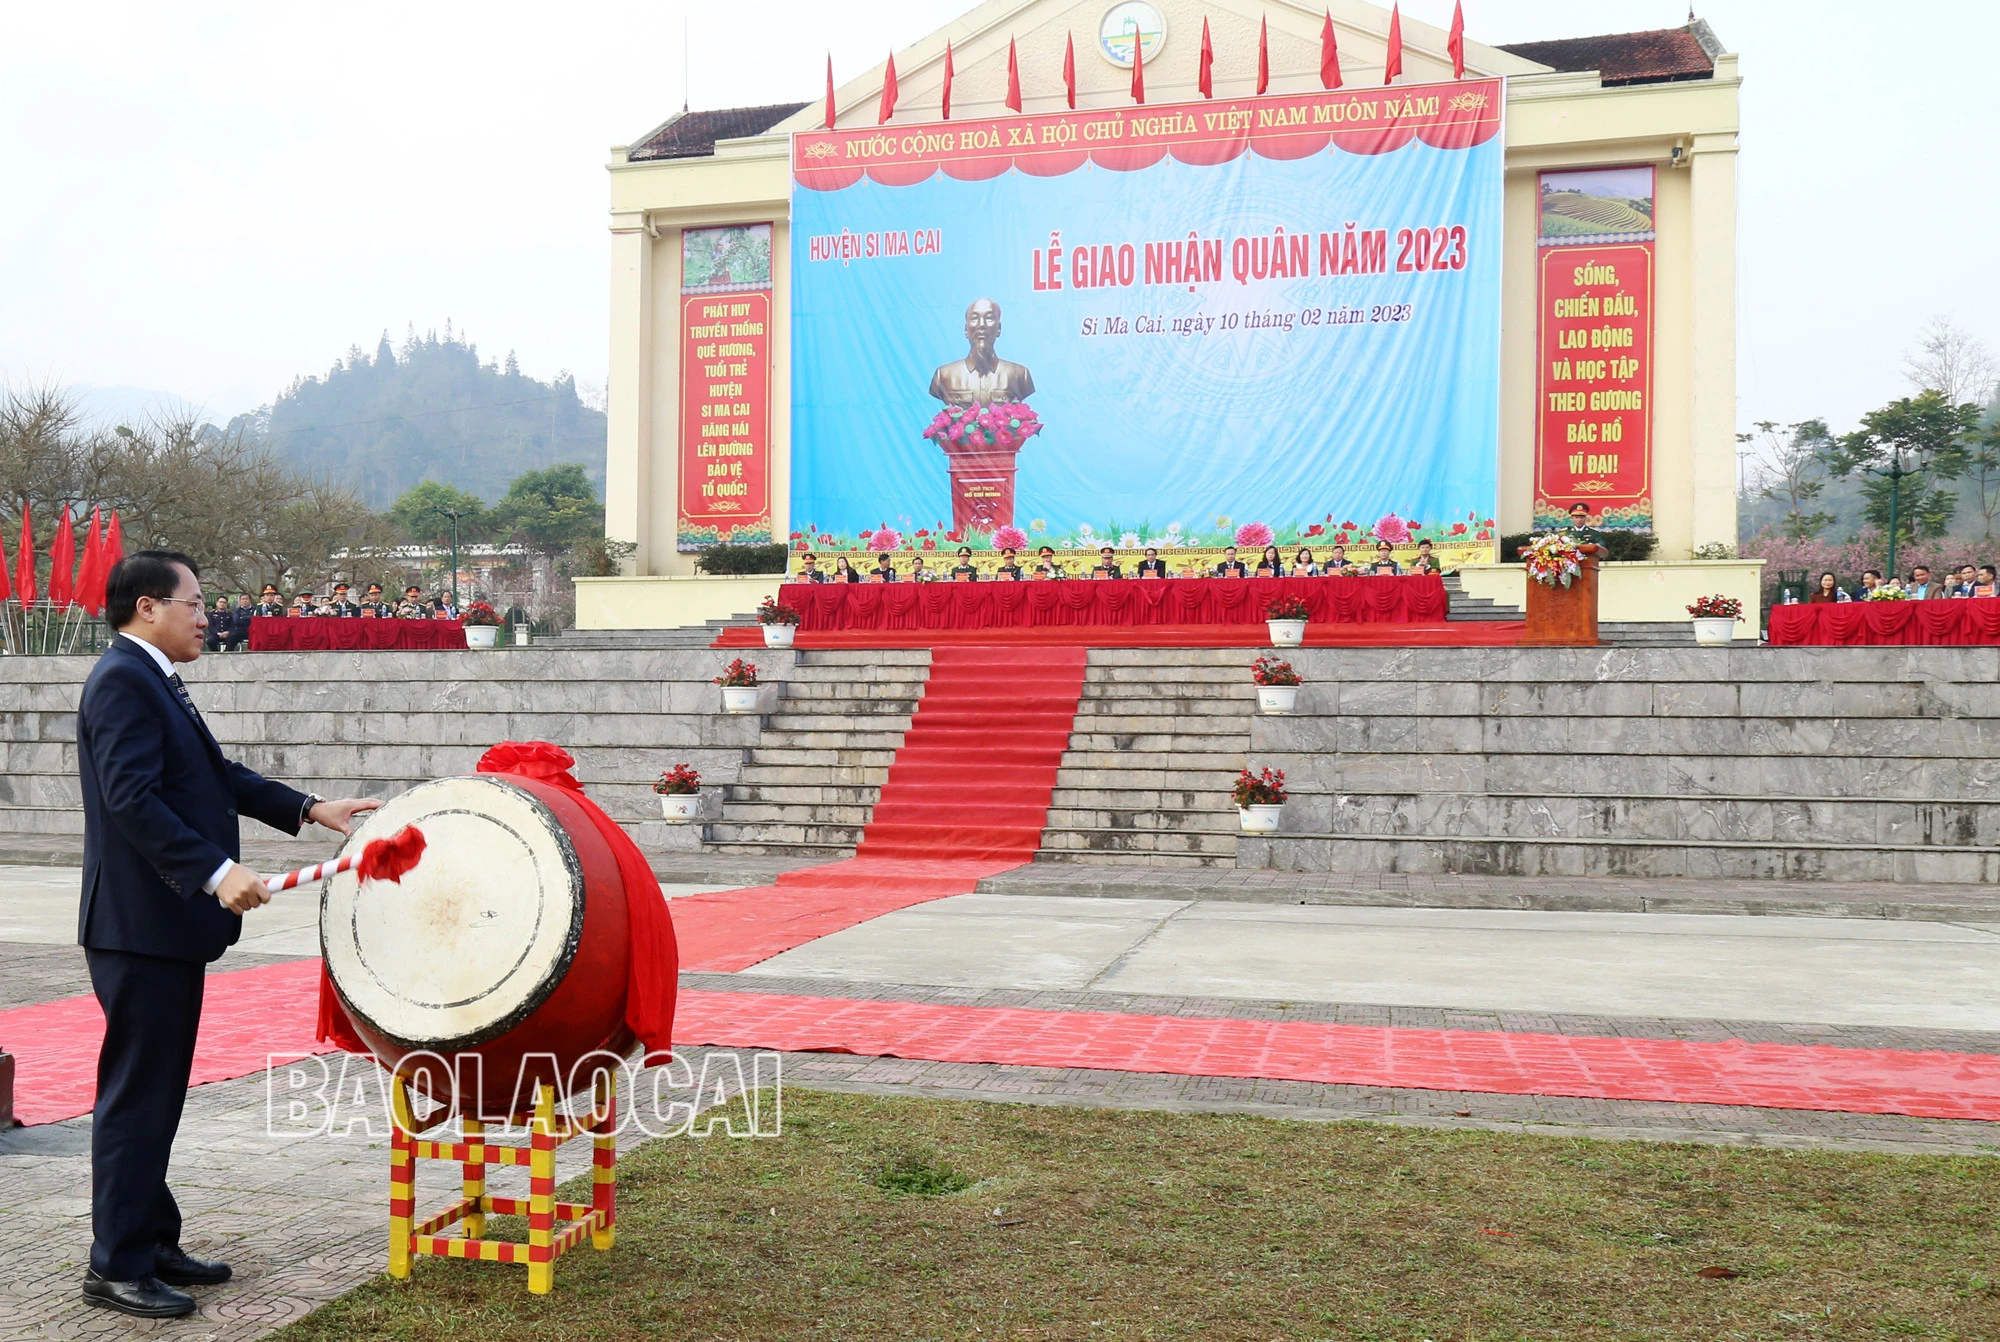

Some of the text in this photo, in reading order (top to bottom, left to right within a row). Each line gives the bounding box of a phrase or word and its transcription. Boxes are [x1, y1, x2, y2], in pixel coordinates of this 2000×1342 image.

[845, 92, 1440, 159] NƯỚC CỘNG HOÀ XÃ HỘI CHỦ NGHĨA VIỆT NAM MUÔN NĂM!
[810, 228, 941, 266] HUYỆN SI MA CAI
[1033, 222, 1467, 293] LỄ GIAO NHẬN QUÂN NĂM 2023
[1574, 260, 1620, 288] SỐNG,
[703, 303, 751, 318] PHÁT HUY
[1554, 290, 1639, 318] CHIẾN ĐẤU,
[690, 319, 763, 339] TRUYỀN THỐNG
[1081, 304, 1413, 337] Si Ma Cai, ngày 10 tháng 02 năm 2023
[1559, 324, 1633, 352] LAO ĐỘNG
[697, 341, 756, 359] QUÊ HƯƠNG,
[704, 358, 747, 378] TUỔI TRẺ
[1552, 356, 1639, 384] VÀ HỌC TẬP
[709, 381, 742, 399] HUYỆN
[1549, 390, 1642, 413] THEO GƯƠNG
[701, 403, 750, 417] SI MA CAI
[702, 420, 749, 437] HĂNG HÁI
[1567, 416, 1623, 444] BÁC HỒ
[697, 440, 753, 457] LÊN ĐƯỜNG
[707, 458, 742, 478] BẢO VỆ
[1569, 451, 1619, 478] VĨ ĐẠI!
[702, 478, 747, 497] TỔ QUỐC!
